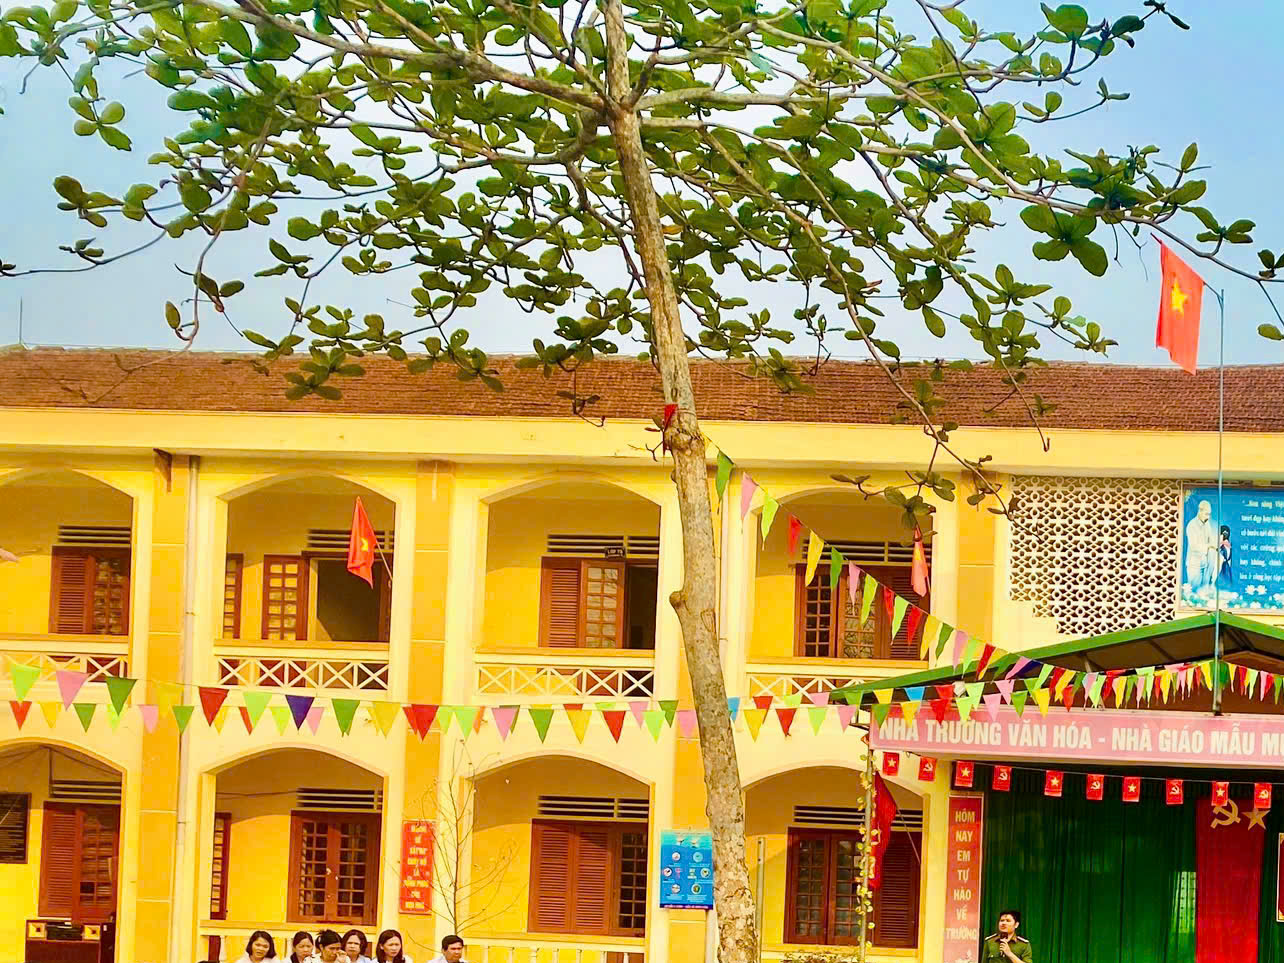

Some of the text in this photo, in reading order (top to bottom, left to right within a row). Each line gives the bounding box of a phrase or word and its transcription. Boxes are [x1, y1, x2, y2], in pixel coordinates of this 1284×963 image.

[1007, 719, 1047, 747] VĂN
[1052, 720, 1092, 749] HÓA
[1111, 724, 1152, 752] NHÀ
[1158, 725, 1204, 754] GIÁO
[1210, 722, 1255, 756] MẪU
[955, 808, 976, 823] HÔM
[955, 831, 973, 842] NAY
[957, 850, 971, 862] EM
[957, 868, 969, 883] TỰ
[953, 886, 971, 901] HÀO
[955, 905, 968, 920] VỀ
[946, 924, 977, 941] TRƯỜNG
